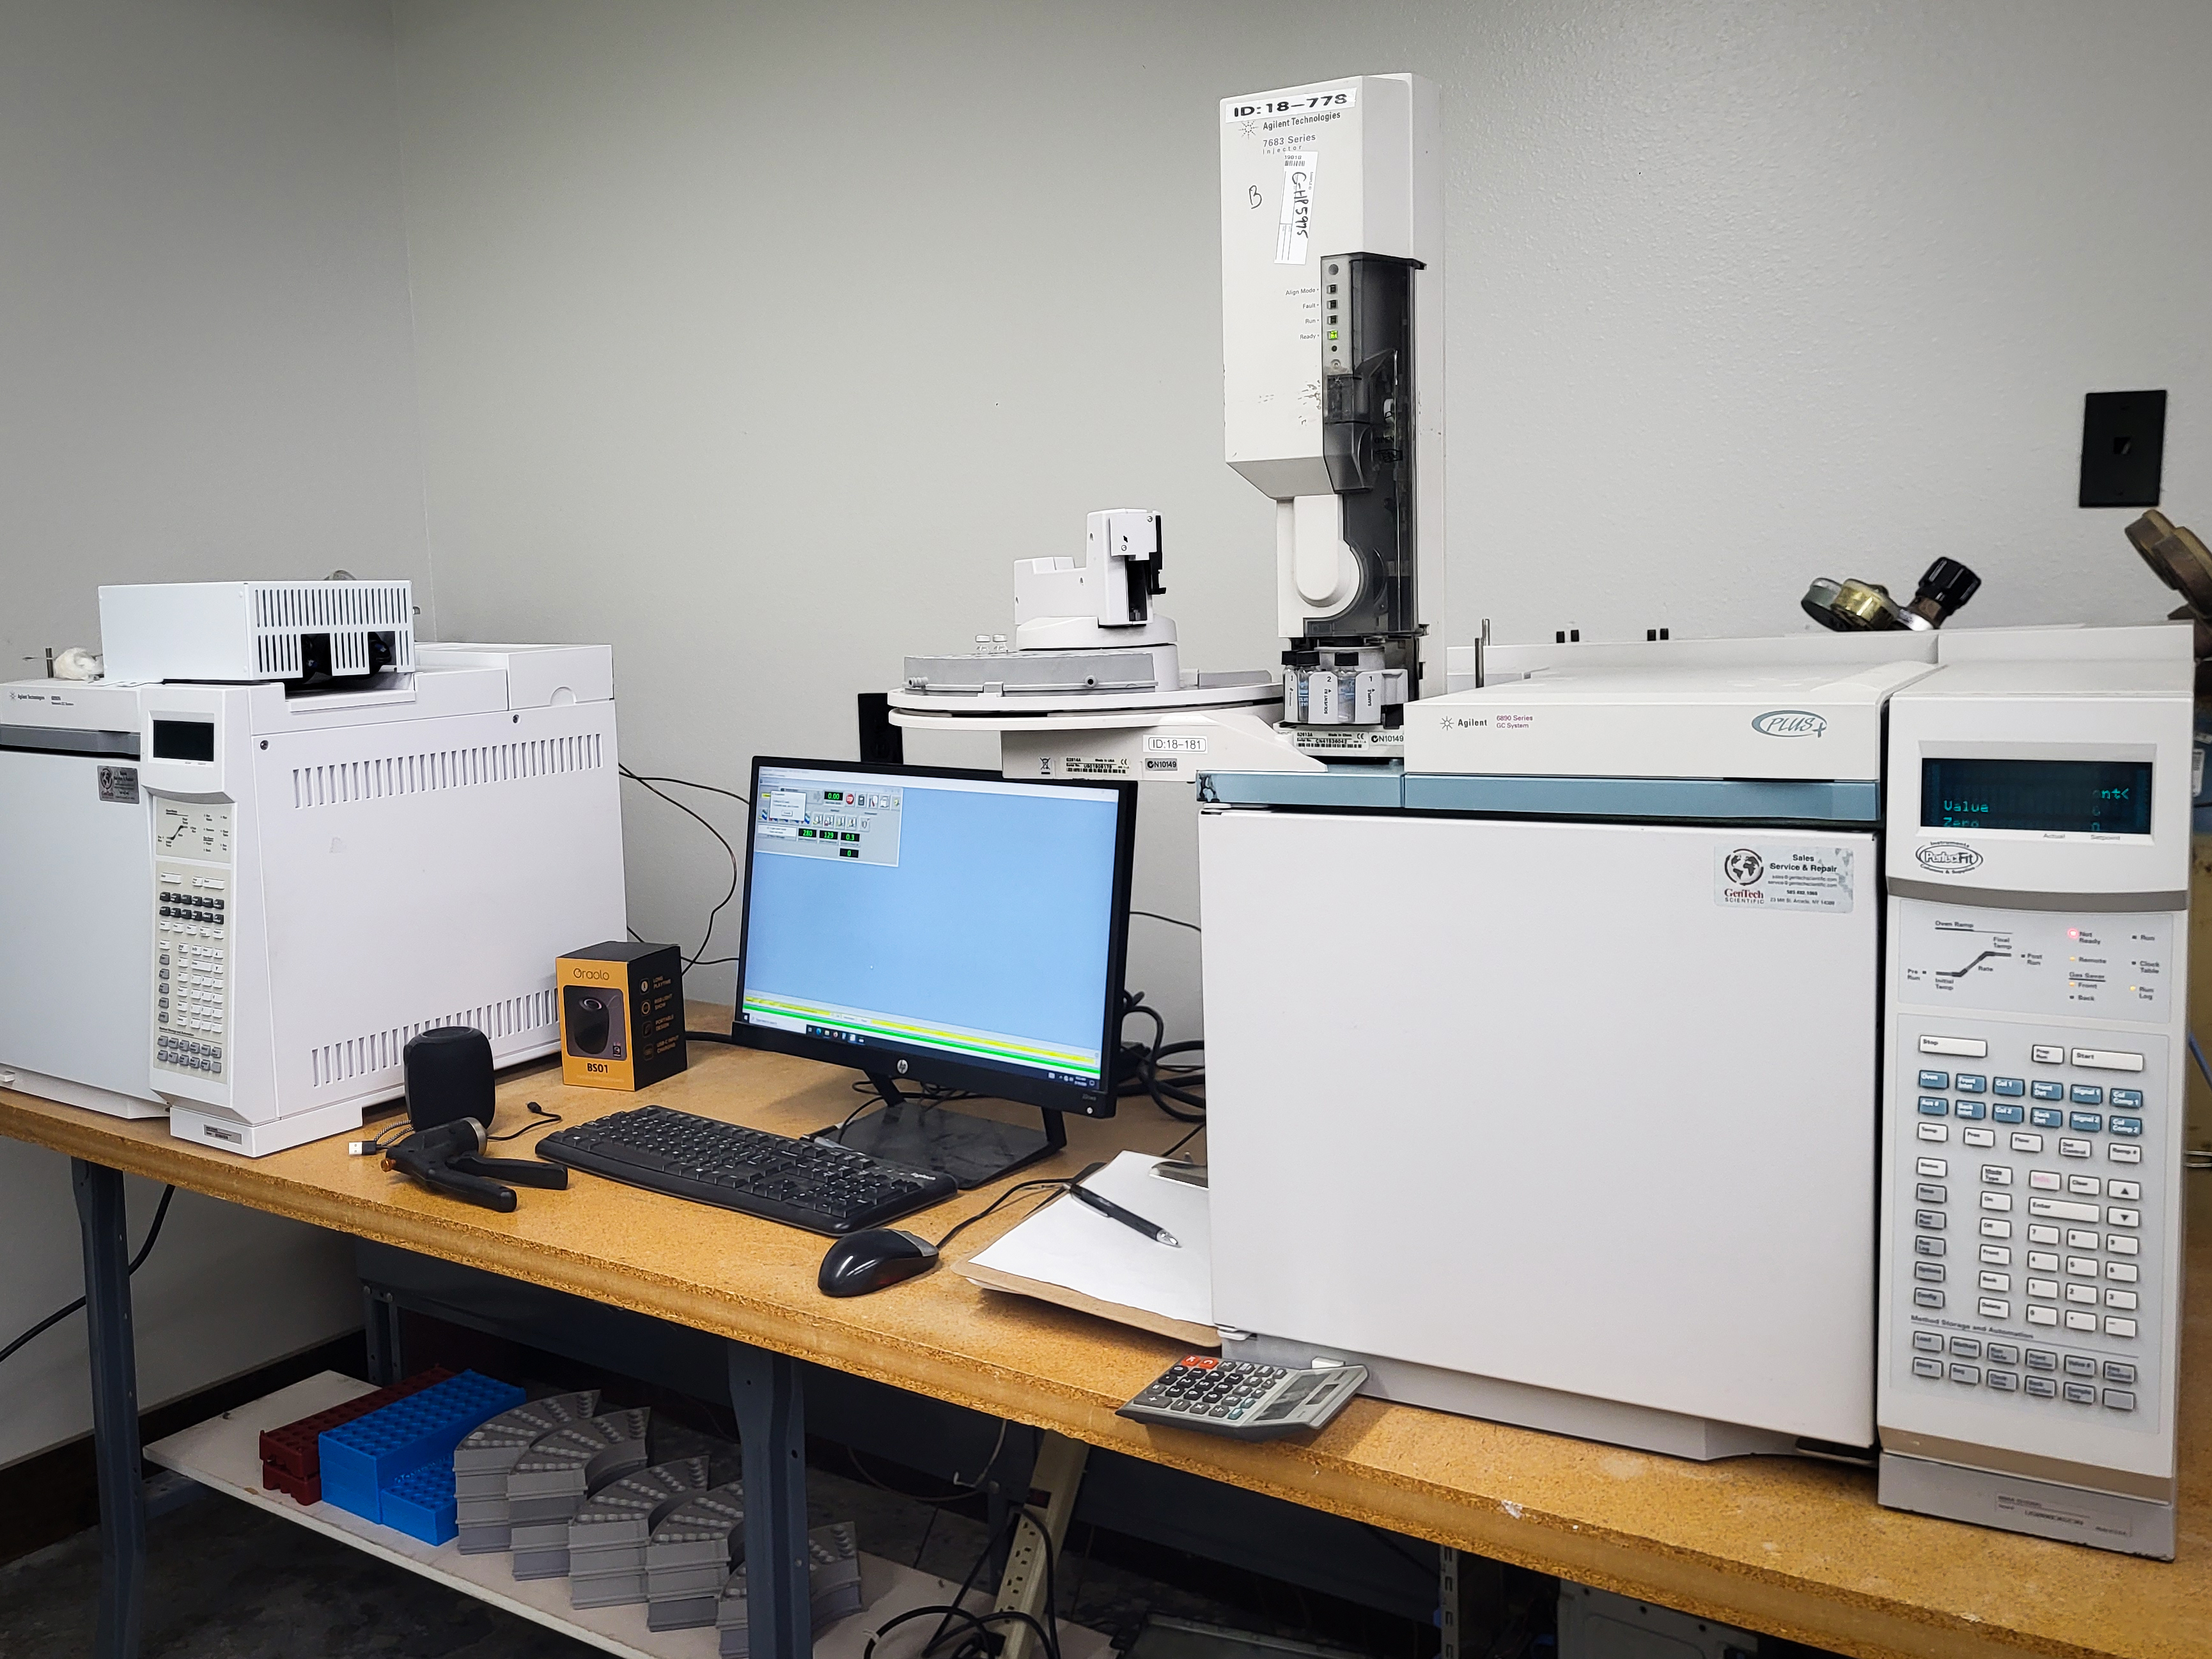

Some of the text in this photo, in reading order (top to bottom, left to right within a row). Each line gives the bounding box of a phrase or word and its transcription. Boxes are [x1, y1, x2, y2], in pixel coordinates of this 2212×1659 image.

[1263, 112, 1341, 131] Agilent Technologies
[1263, 134, 1316, 148] 7683 Series
[1263, 144, 1302, 155] Injector
[1249, 185, 1263, 209] B
[1458, 718, 1488, 728] Agilent
[1153, 738, 1201, 750] ID:18-181
[1943, 800, 1990, 813] Value
[1793, 853, 1814, 862] Sales
[1770, 862, 1800, 871] Service
[1811, 865, 1837, 874] Repair
[1724, 888, 1764, 899] GenTech
[573, 967, 610, 981] Oraolo
[2076, 1052, 2094, 1061] Start
[587, 1063, 609, 1073] BS01
[1910, 1314, 1940, 1324] Method
[1941, 1319, 1970, 1330] Storage
[1988, 1327, 2034, 1339] Automation
